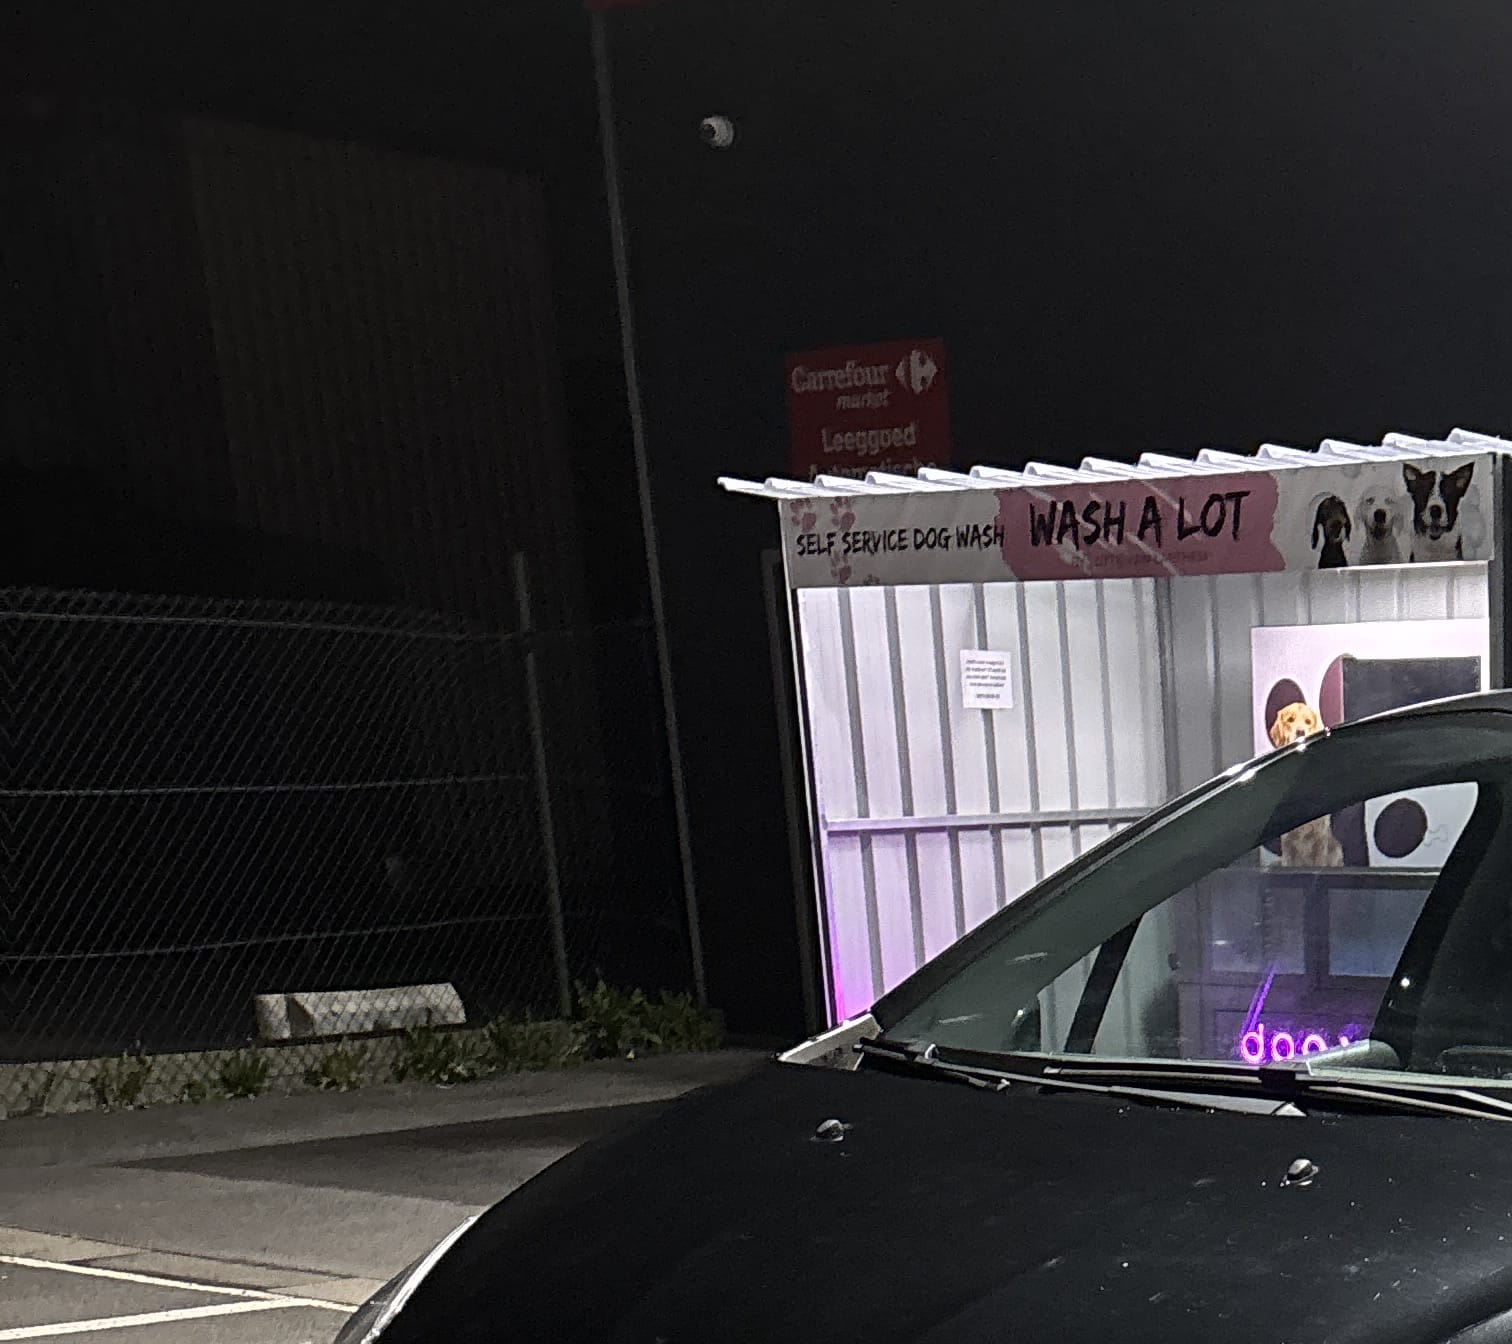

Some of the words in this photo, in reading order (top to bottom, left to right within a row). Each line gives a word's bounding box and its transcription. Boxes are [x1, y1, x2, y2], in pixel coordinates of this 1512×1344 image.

[791, 360, 889, 393] Carrefour
[836, 388, 892, 411] market
[821, 421, 917, 457] Leeggoed
[1029, 499, 1127, 550] WASH
[1137, 495, 1162, 548] A
[1177, 490, 1251, 541] LOT
[796, 532, 837, 556] SELF
[841, 528, 909, 556] SERVICE
[913, 526, 952, 551] DOG
[956, 523, 1005, 551] WASH
